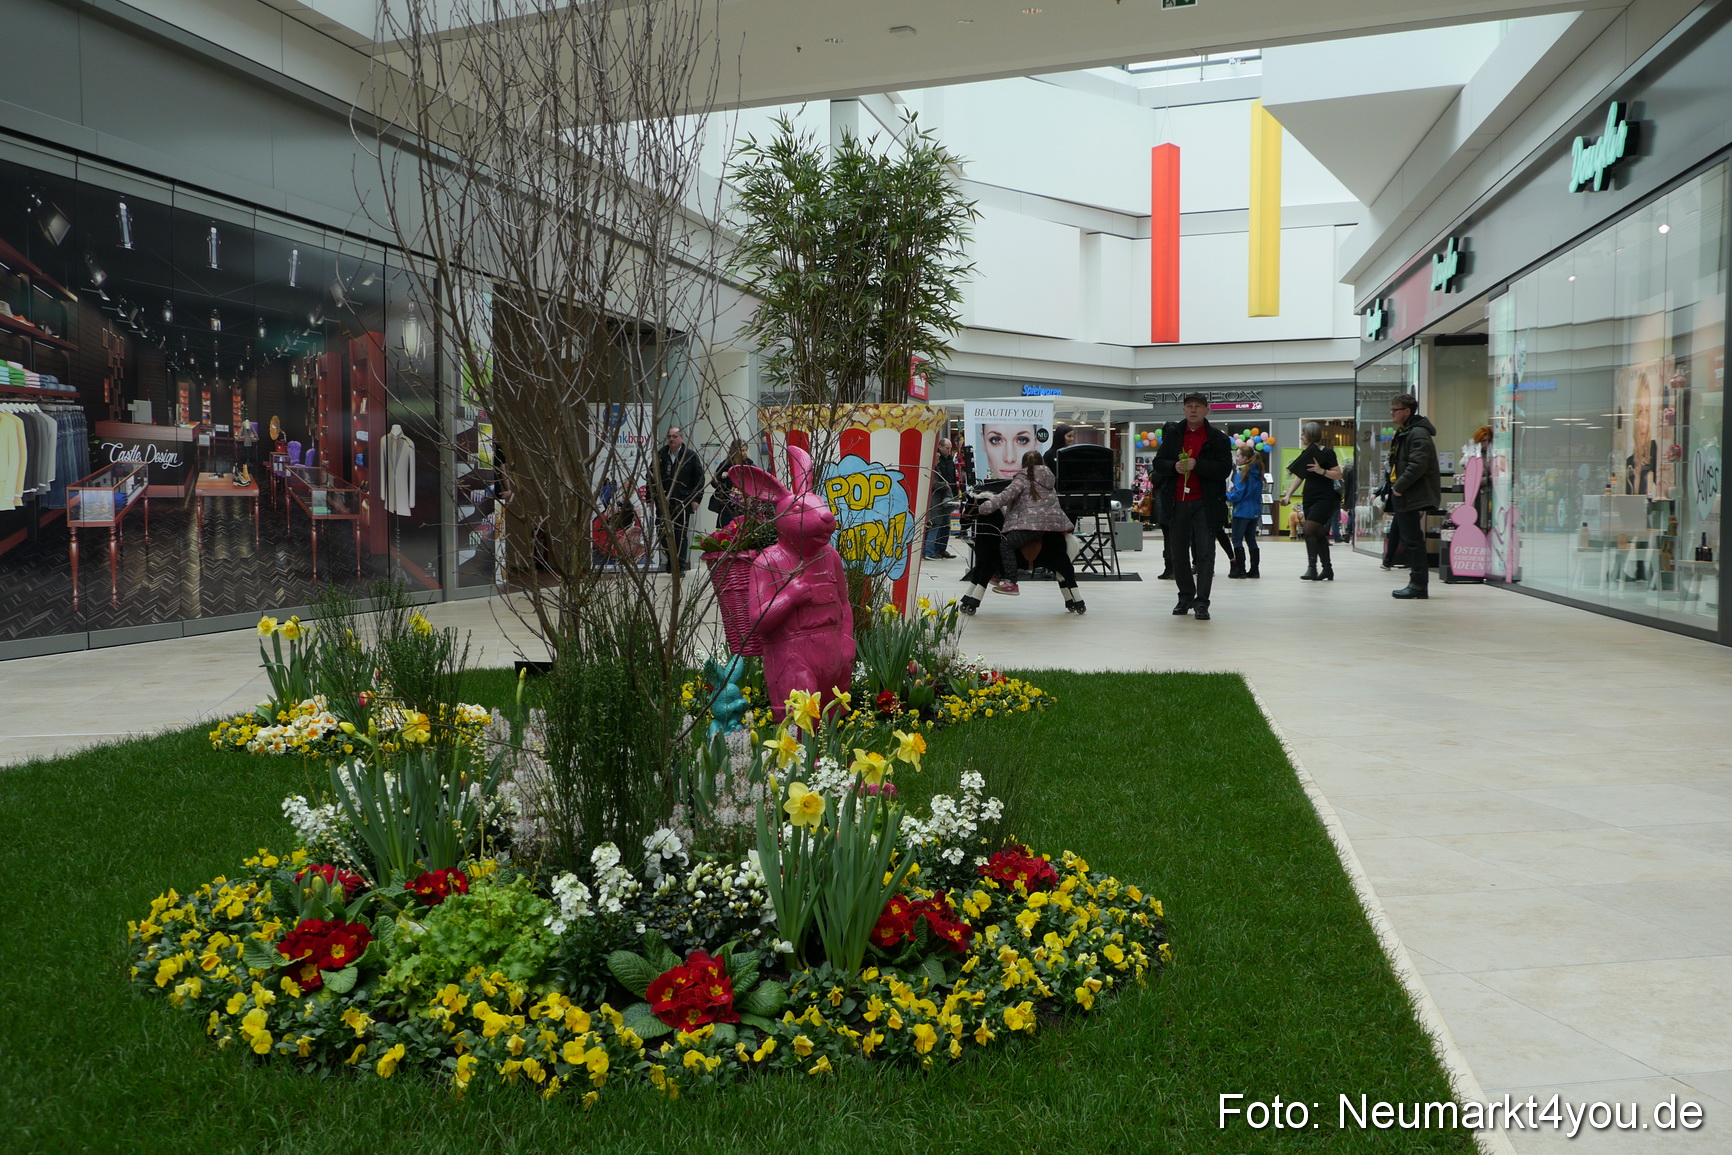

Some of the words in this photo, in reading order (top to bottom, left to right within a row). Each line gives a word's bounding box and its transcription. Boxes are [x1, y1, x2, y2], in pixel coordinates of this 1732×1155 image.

[1022, 384, 1063, 396] Spielwaren
[1142, 390, 1263, 403] STYBOXX
[974, 408, 1019, 417] BEAUTIFY
[1022, 409, 1044, 418] YOU!
[101, 442, 143, 463] Castle
[144, 443, 183, 469] Design
[825, 473, 892, 515] POP
[835, 512, 907, 562] ORN!
